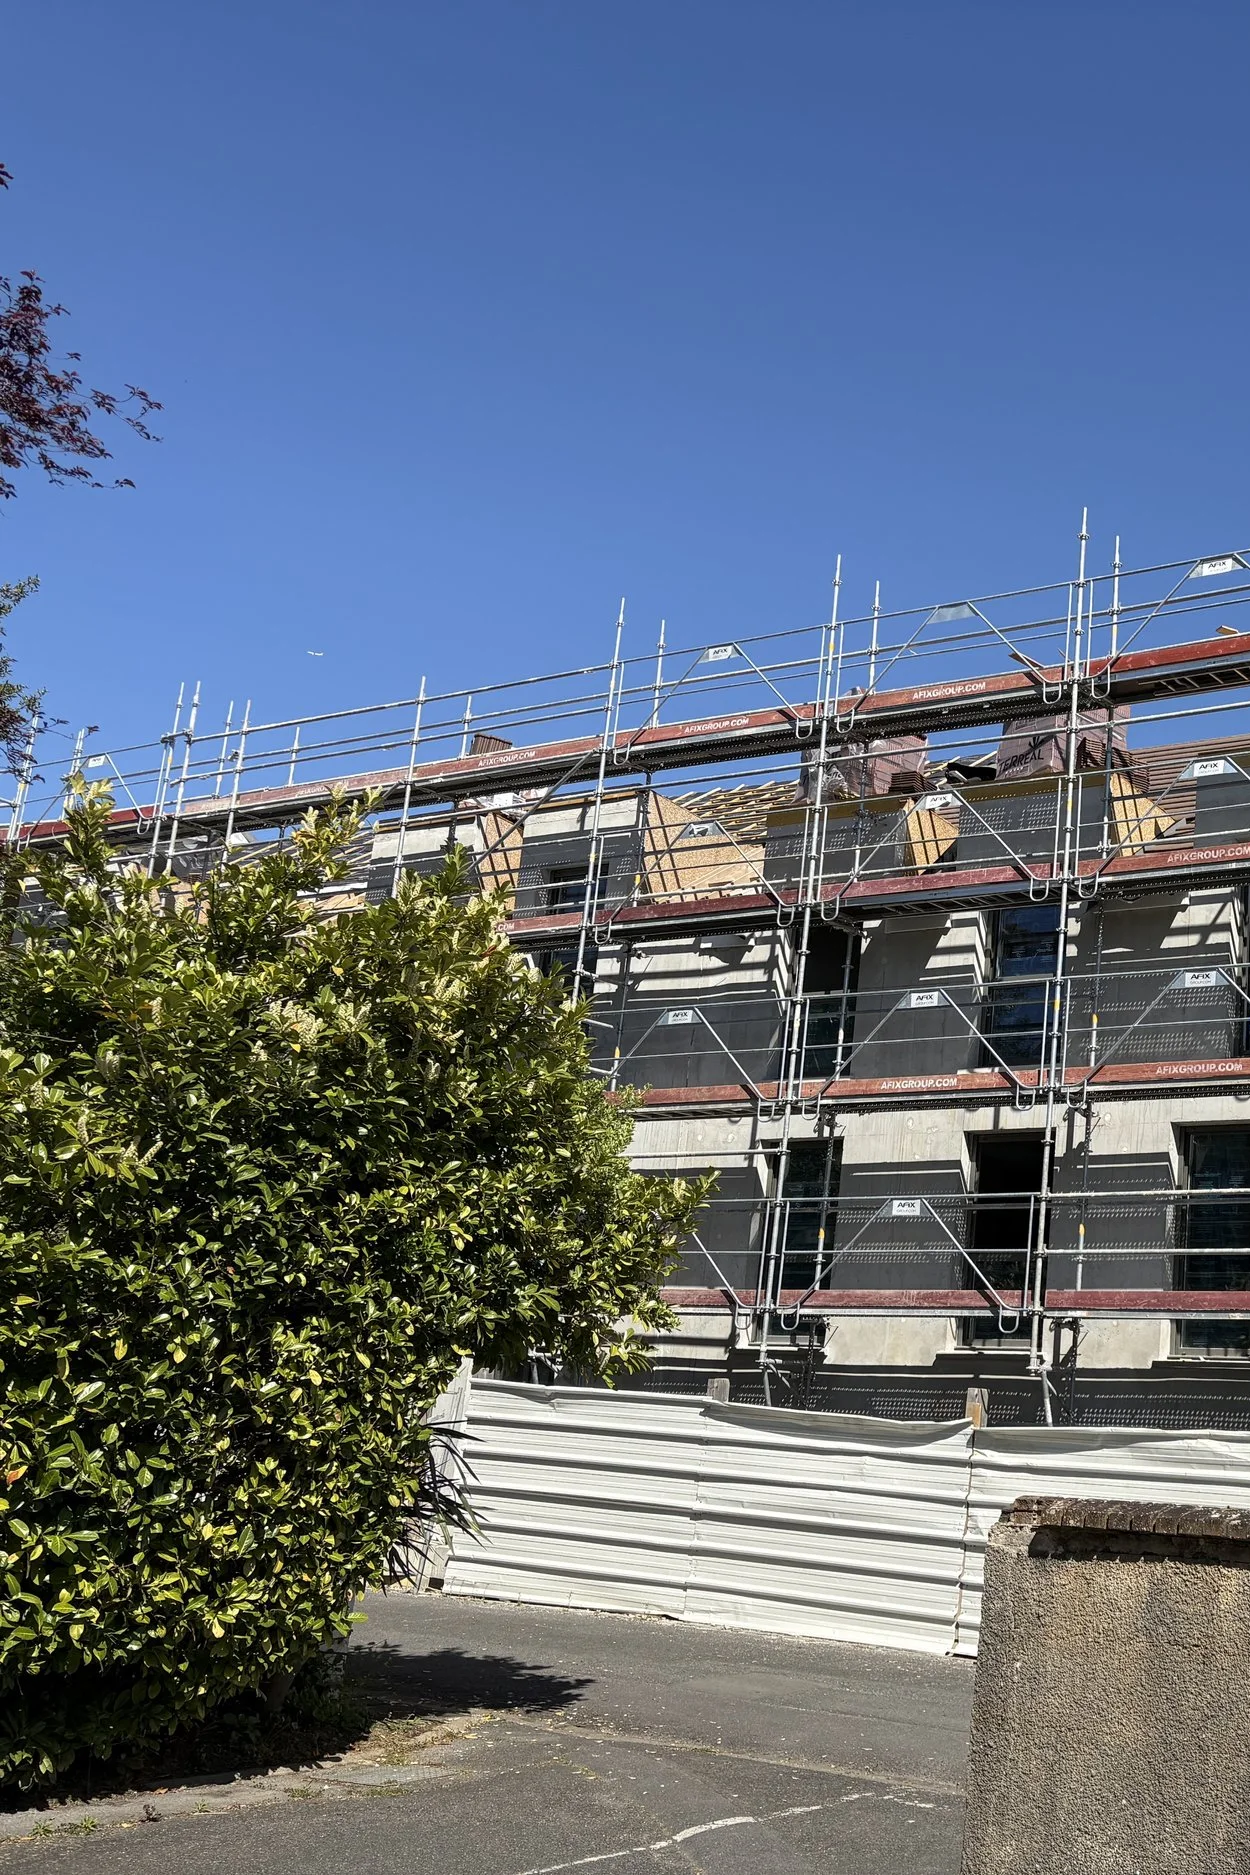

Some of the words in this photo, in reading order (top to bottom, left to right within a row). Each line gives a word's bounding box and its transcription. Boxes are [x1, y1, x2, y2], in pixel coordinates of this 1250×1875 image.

[912, 682, 986, 700] AFIXGROUP.COM
[684, 718, 750, 734] AFIXGROUP.COM
[478, 751, 536, 767] AFIXGROUP.COM
[998, 748, 1044, 773] TERREAL
[1155, 1062, 1243, 1075] AFIXGROUP.COM
[880, 1078, 958, 1090] AFIXGROUP.COM
